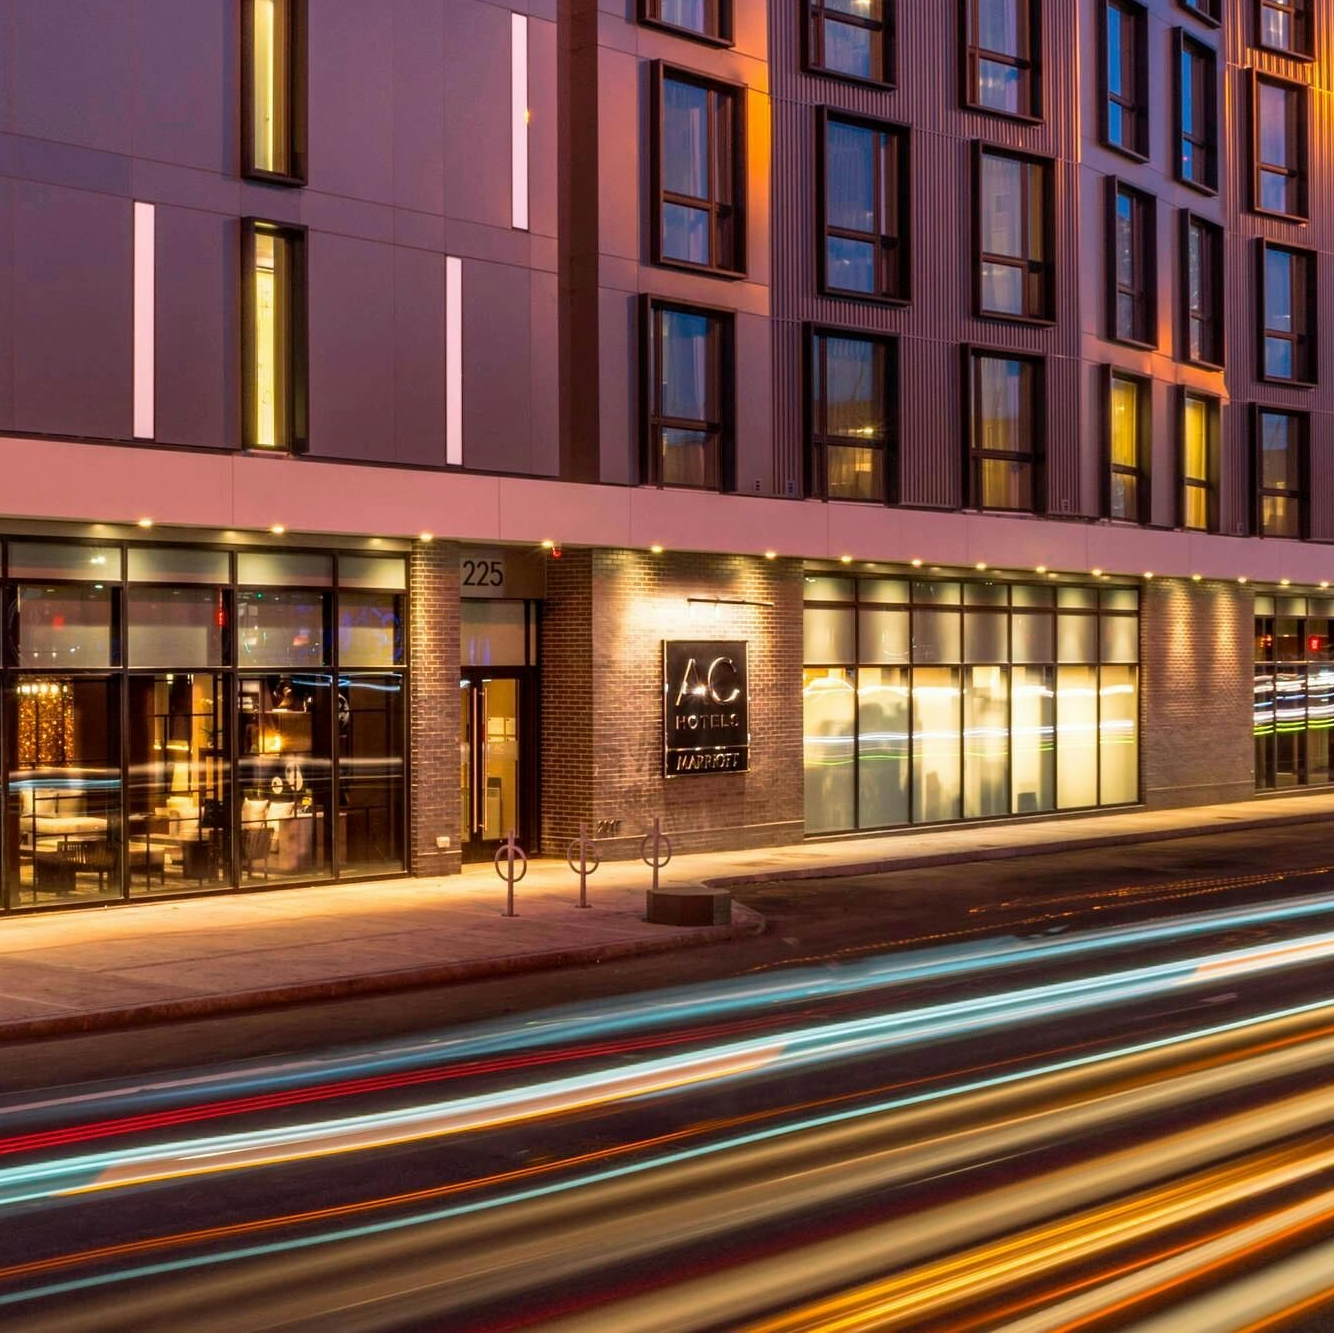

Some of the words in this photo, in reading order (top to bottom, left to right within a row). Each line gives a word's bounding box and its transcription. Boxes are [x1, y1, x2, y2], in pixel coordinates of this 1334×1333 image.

[463, 560, 503, 586] 225
[675, 656, 740, 706] AC
[675, 713, 740, 730] HOTELS
[676, 752, 740, 771] MARRIOTT
